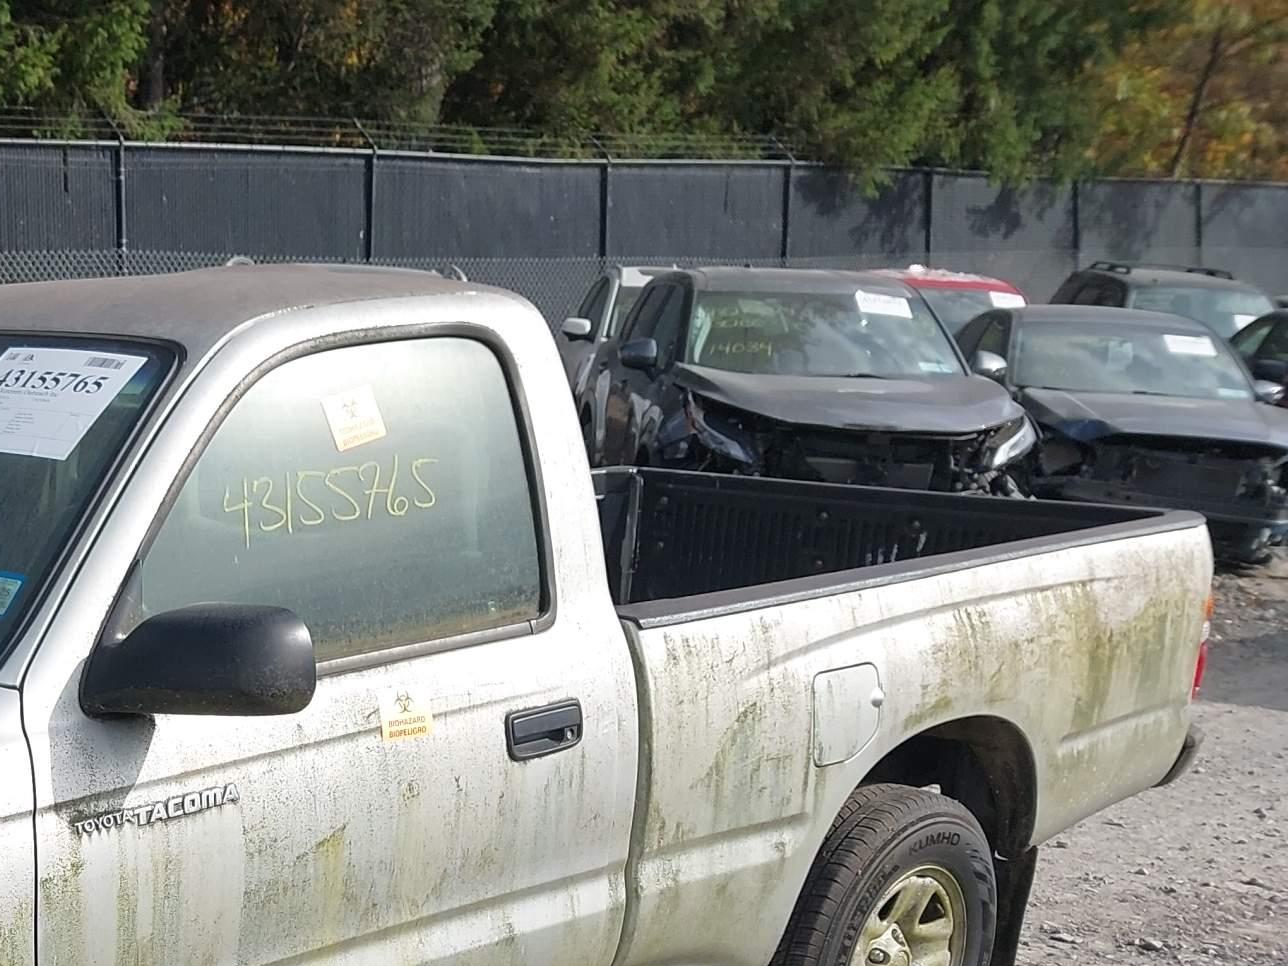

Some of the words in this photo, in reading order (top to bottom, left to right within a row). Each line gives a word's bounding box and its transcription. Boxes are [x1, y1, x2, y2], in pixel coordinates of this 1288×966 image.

[223, 452, 440, 550] 43155765
[74, 809, 136, 835] TOYOTA
[132, 783, 240, 827] TACOMA
[909, 831, 962, 857] KUMHO
